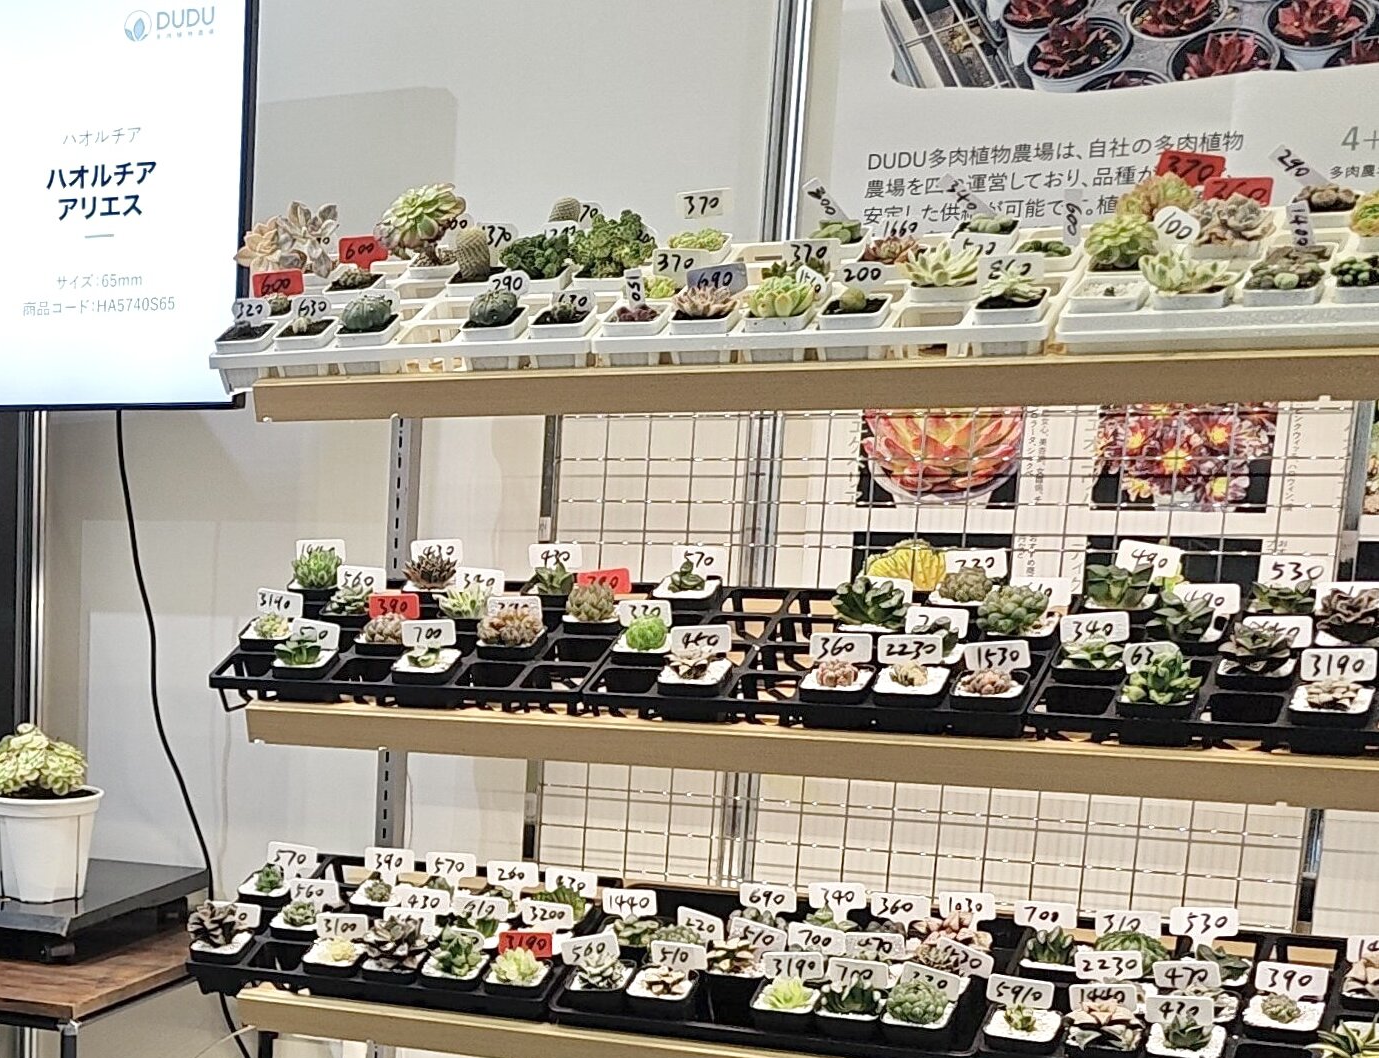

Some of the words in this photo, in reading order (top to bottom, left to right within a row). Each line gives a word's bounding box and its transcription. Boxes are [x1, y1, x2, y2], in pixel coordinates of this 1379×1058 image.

[157, 6, 215, 30] DUDU
[63, 126, 142, 147] ハオルチア
[46, 161, 157, 189] ハオルチア
[58, 194, 143, 221] アリエス
[684, 195, 720, 215] 370
[883, 220, 918, 236] 1660
[1158, 212, 1193, 240] 100
[347, 242, 375, 258] 600
[657, 254, 694, 272] 370
[696, 271, 733, 289] 690
[843, 267, 882, 282] 200
[236, 303, 263, 318] 320
[541, 550, 570, 567] 430
[343, 573, 374, 587] 560
[1270, 562, 1324, 580] 530
[379, 599, 408, 614] 390
[413, 626, 442, 643] 700
[1072, 620, 1114, 642] 340
[821, 637, 855, 653] 360
[886, 642, 936, 658] 2230
[977, 648, 1019, 666] 1530
[1311, 655, 1365, 677] 3190
[375, 853, 403, 871] 390
[434, 857, 465, 874] 570
[294, 885, 324, 899] 560
[749, 889, 786, 908] 690
[407, 895, 441, 910] 430
[609, 894, 650, 909] 1440
[877, 900, 913, 917] 360
[530, 905, 566, 921] 3200
[1186, 914, 1228, 934] 530
[741, 926, 775, 947] 510
[798, 929, 832, 947] 700
[572, 942, 605, 963] 560
[660, 948, 689, 964] 510
[773, 959, 816, 977] 3190
[1083, 958, 1138, 978] 2230
[1269, 970, 1312, 989] 390
